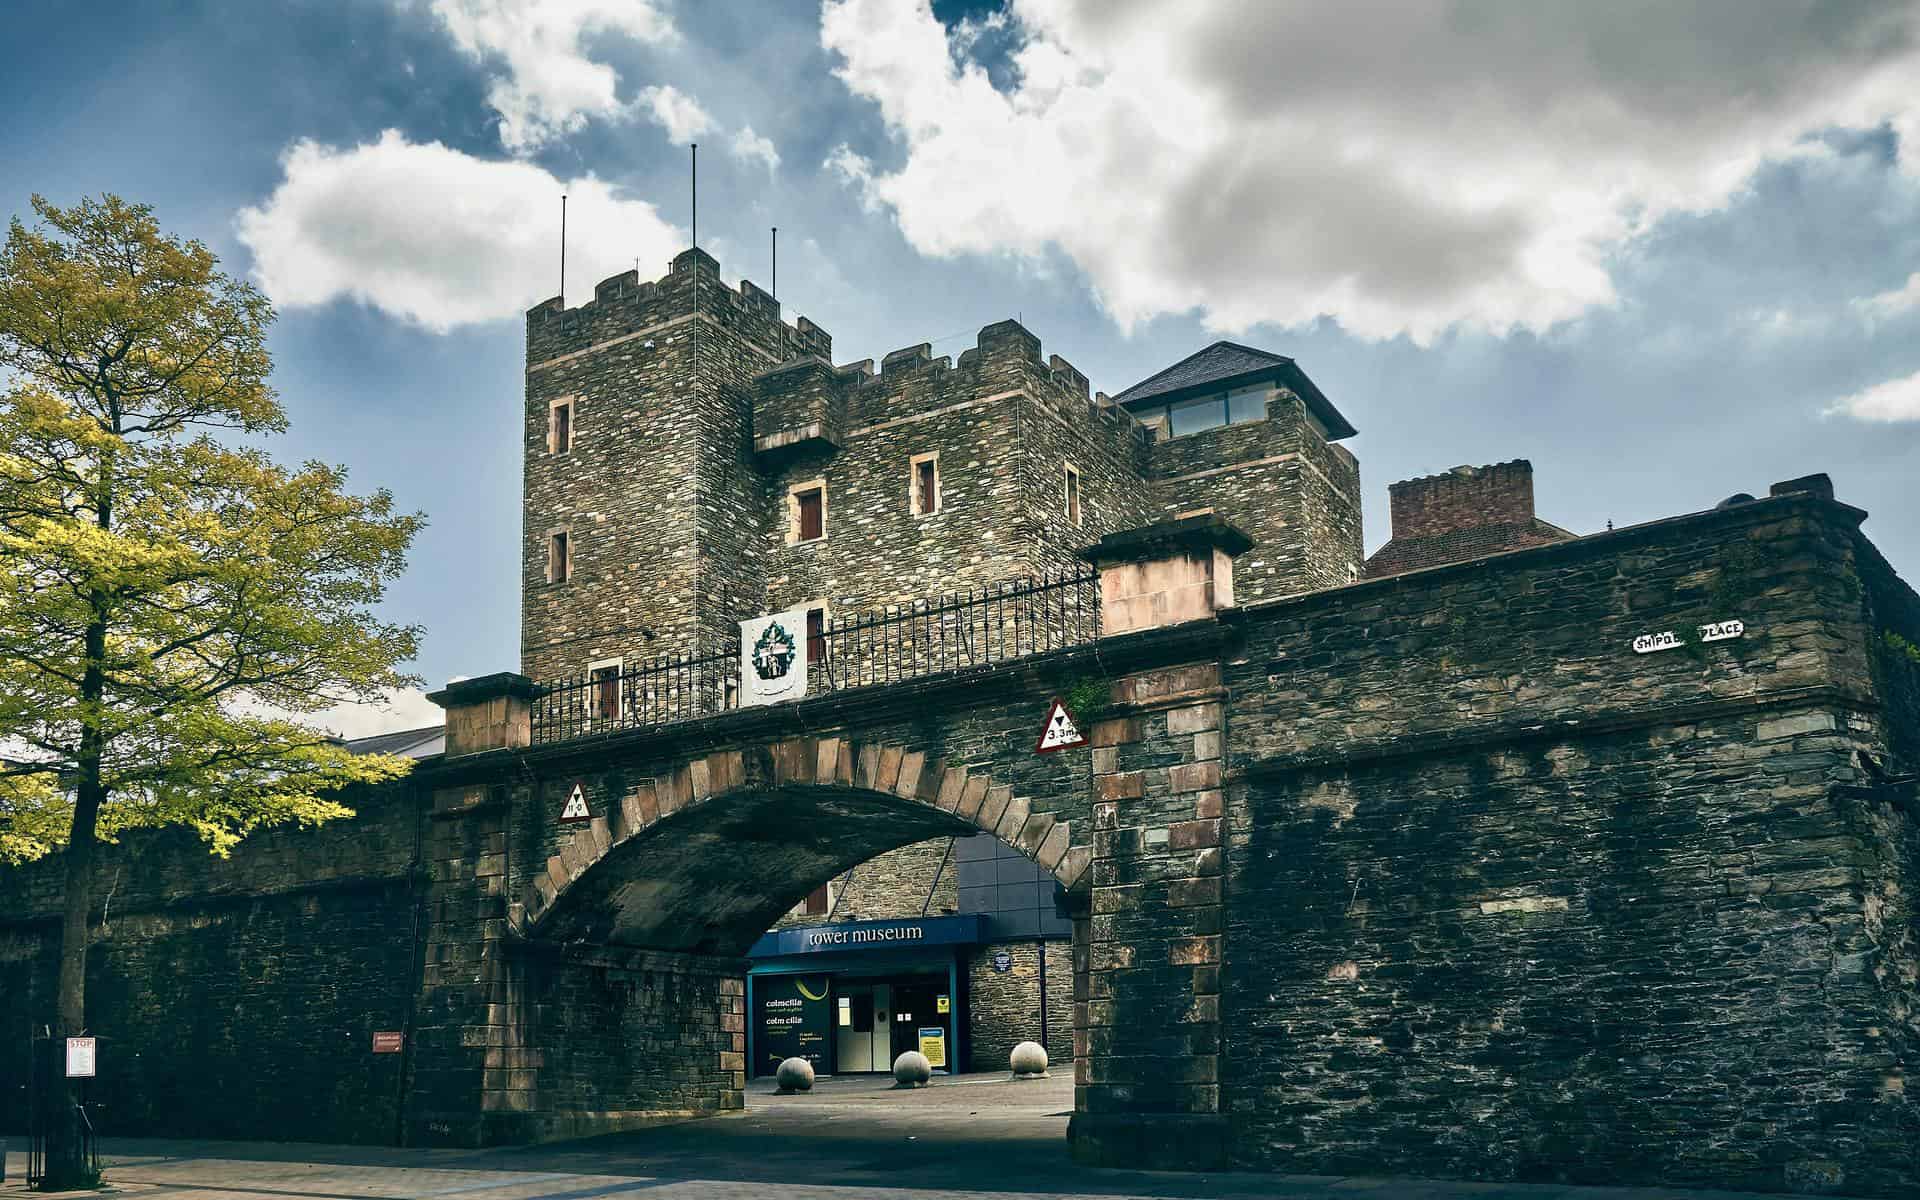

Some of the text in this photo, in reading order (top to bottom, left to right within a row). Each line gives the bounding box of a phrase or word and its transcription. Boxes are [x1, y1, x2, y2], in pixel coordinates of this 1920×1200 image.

[1699, 623, 1741, 638] PLACE
[809, 926, 923, 946] tower museum
[70, 1039, 92, 1048] STOP
